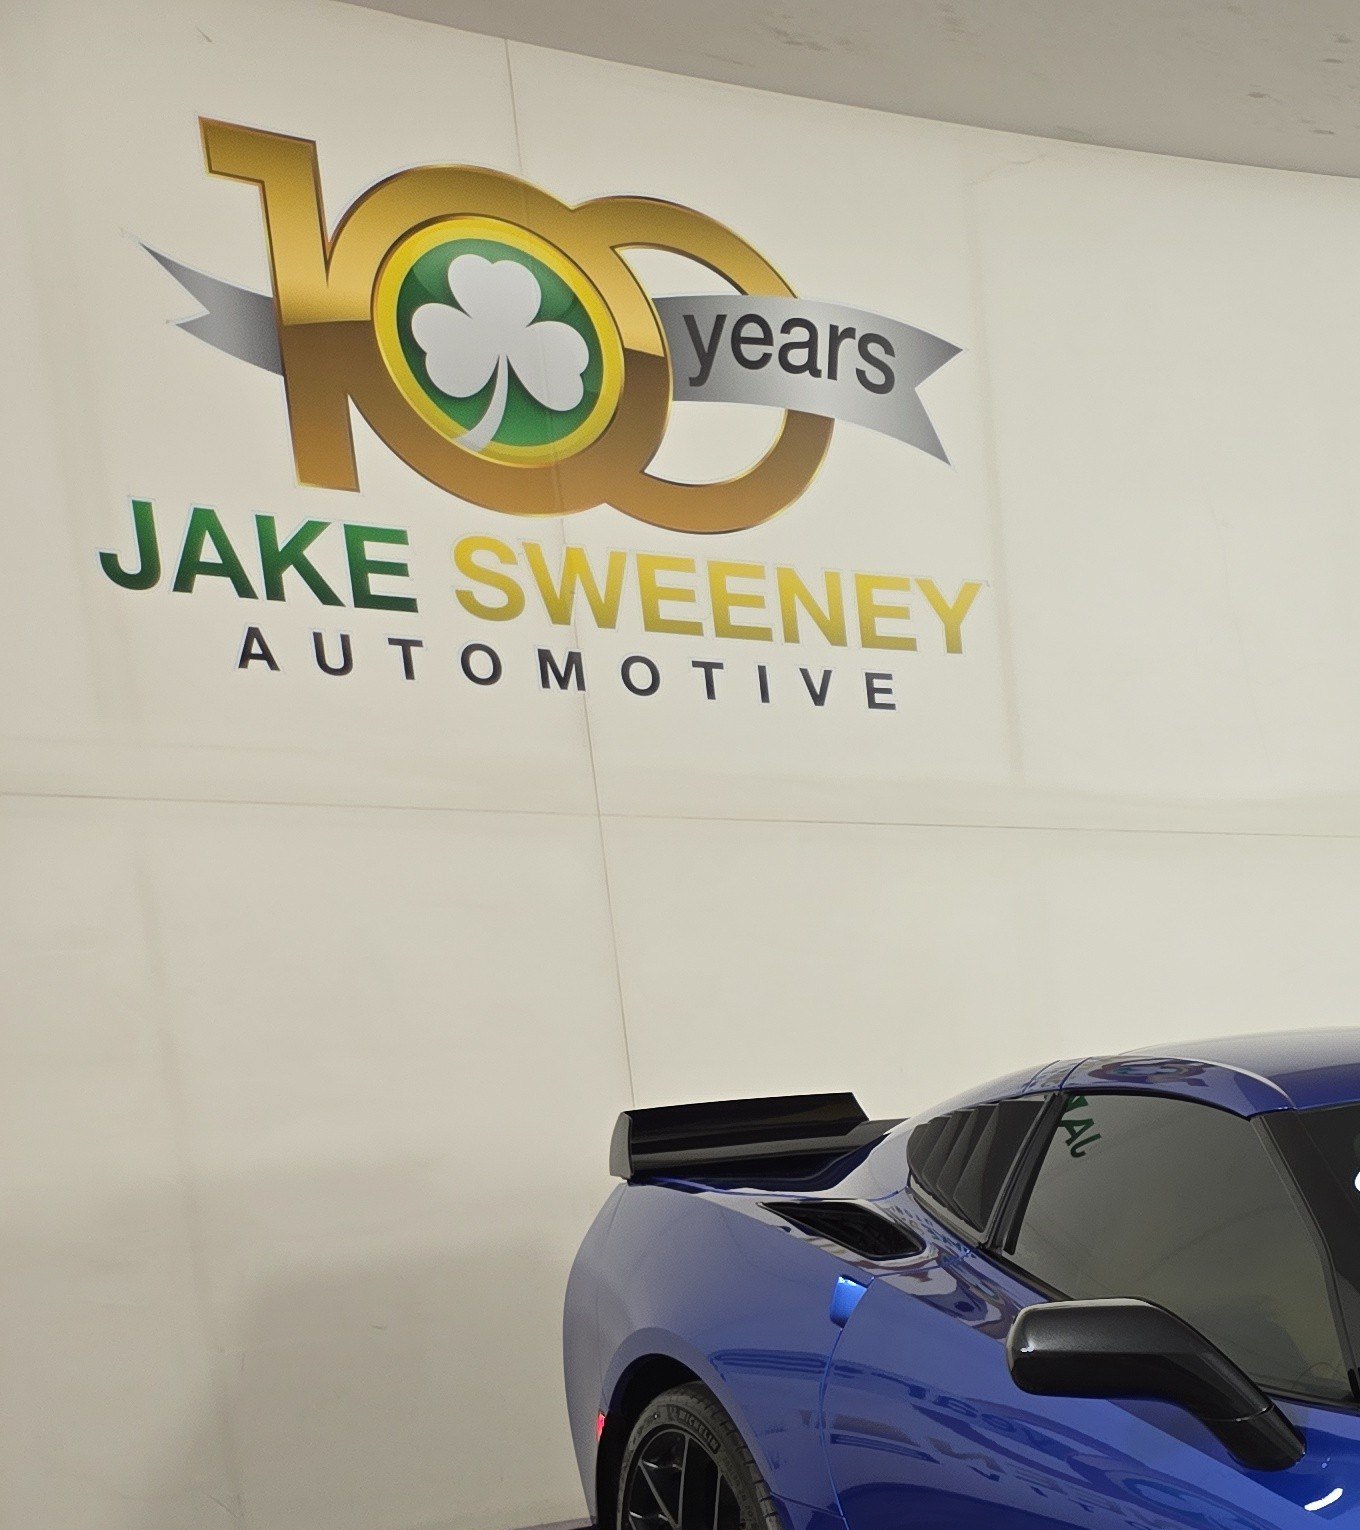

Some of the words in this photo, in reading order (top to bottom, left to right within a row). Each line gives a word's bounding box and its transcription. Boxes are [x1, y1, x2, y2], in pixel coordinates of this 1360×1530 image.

[199, 116, 834, 534] 100
[683, 302, 897, 394] years
[99, 498, 418, 613] JAKE
[453, 536, 986, 655] SWEENEY
[236, 625, 898, 712] AUTOMOTIVE
